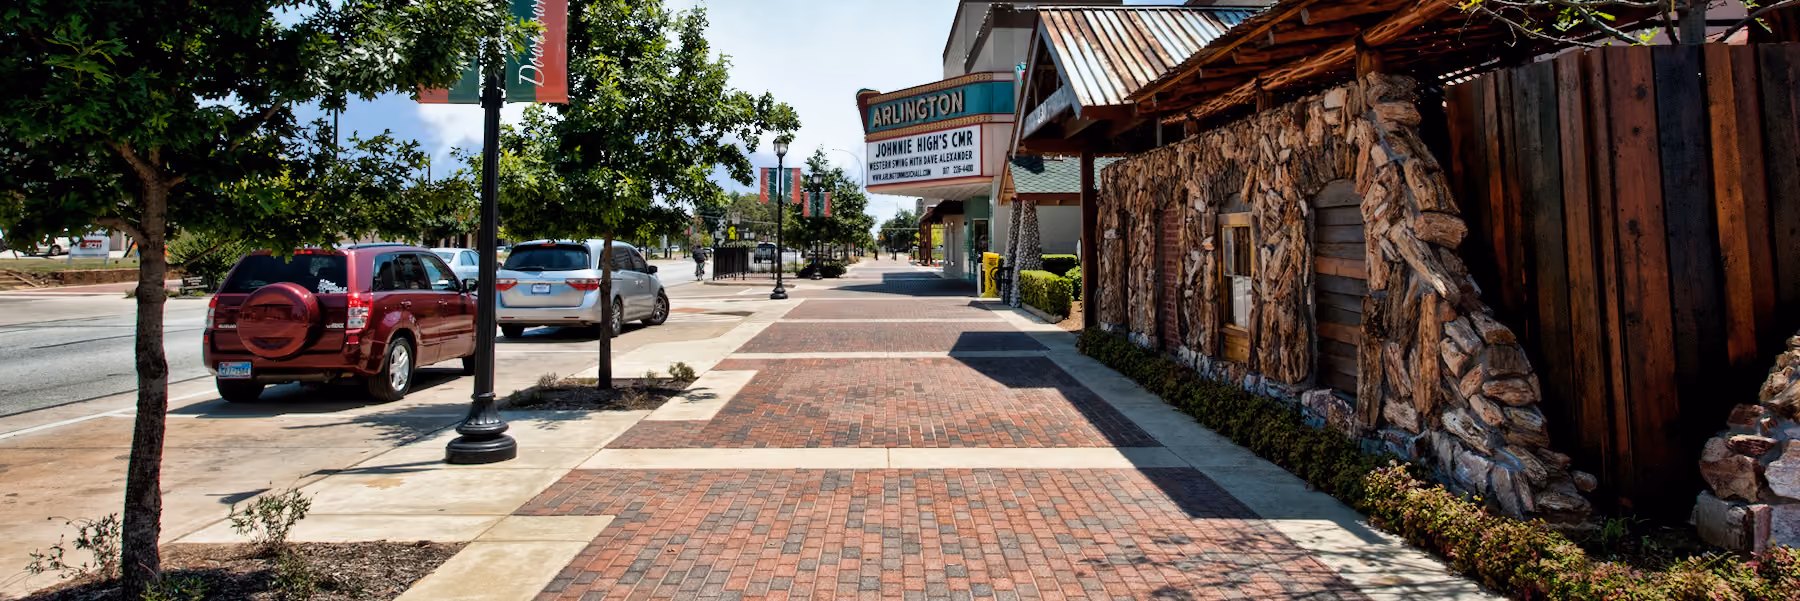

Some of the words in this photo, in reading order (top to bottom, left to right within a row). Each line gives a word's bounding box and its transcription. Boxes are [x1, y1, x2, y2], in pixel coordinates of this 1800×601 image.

[872, 89, 965, 128] ARLINGTON
[875, 140, 912, 158] JOHNNIE
[917, 134, 948, 153] HIGH'S
[952, 130, 973, 148] CMR
[869, 161, 891, 171] WESTERN
[892, 158, 909, 168] SWING
[909, 156, 922, 166] WITH
[923, 154, 938, 165] DAVE
[939, 150, 973, 163] ALEXANDER
